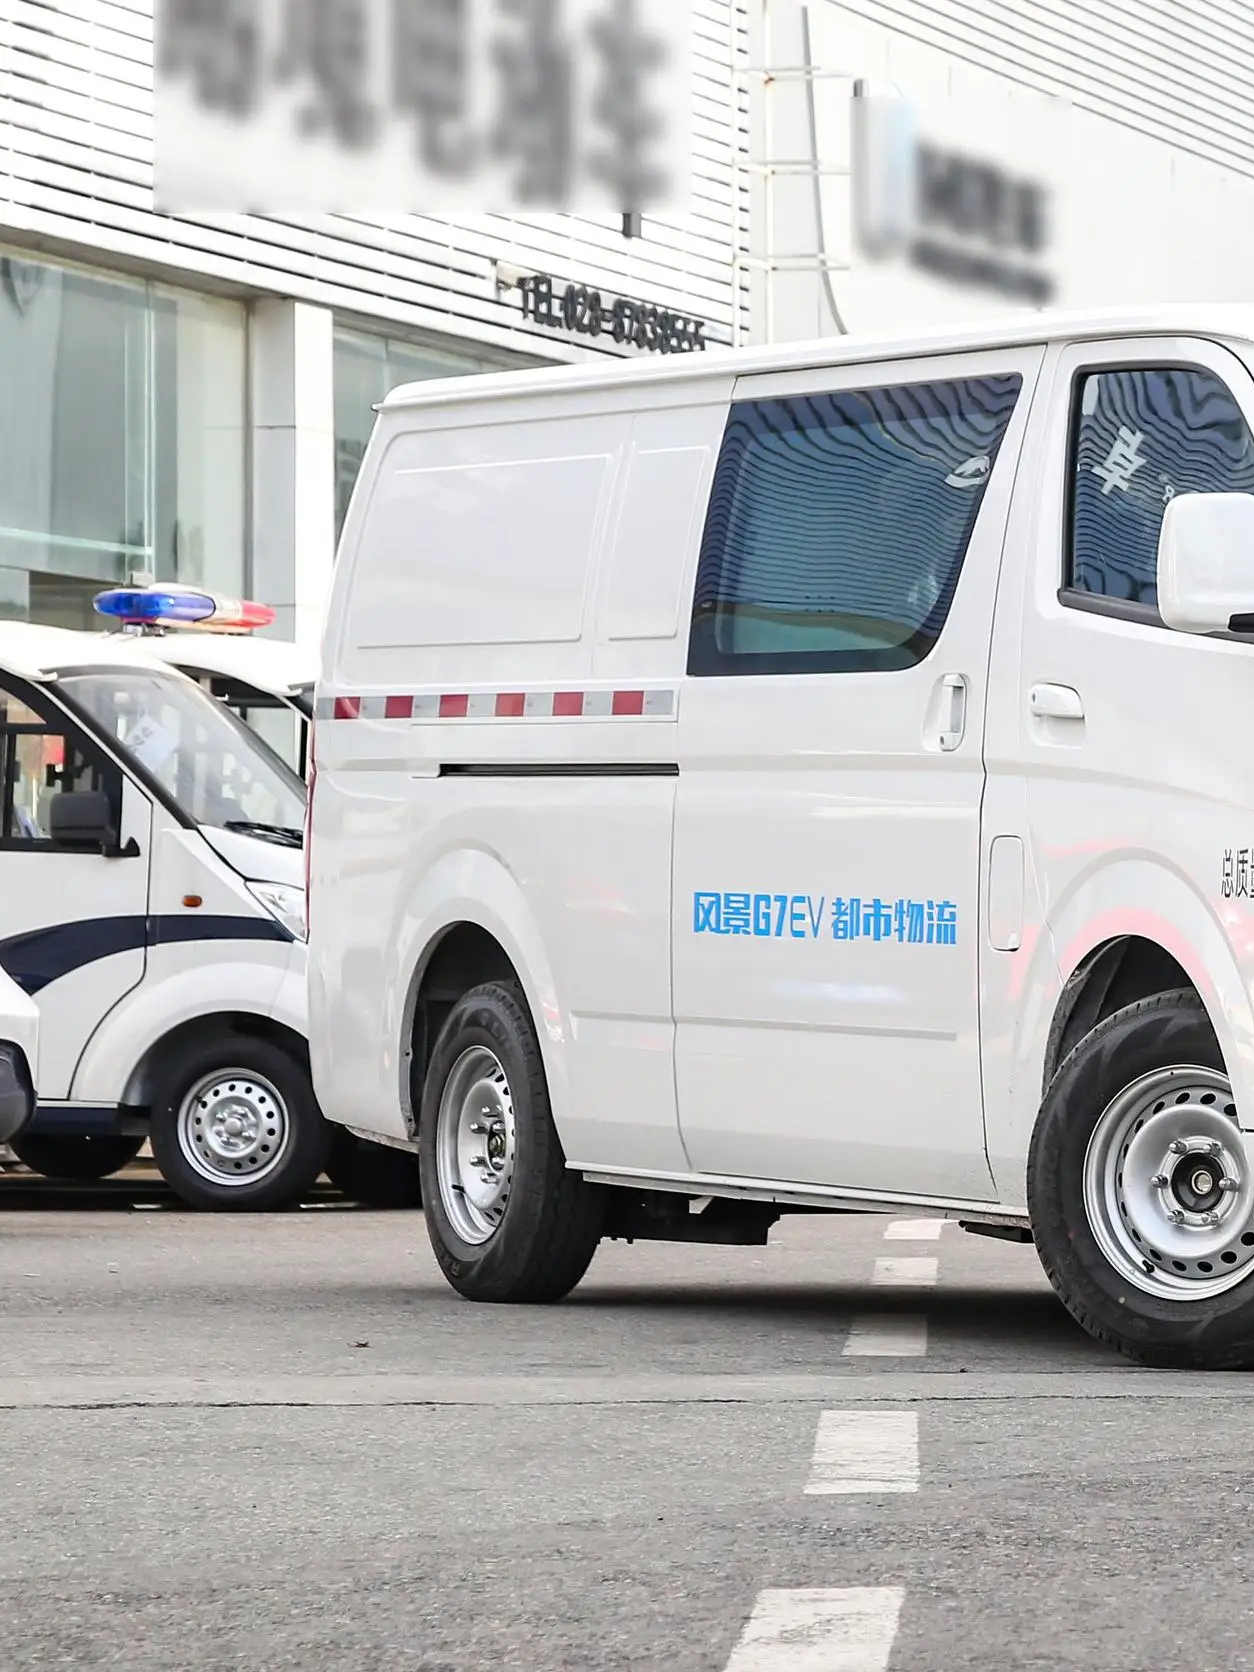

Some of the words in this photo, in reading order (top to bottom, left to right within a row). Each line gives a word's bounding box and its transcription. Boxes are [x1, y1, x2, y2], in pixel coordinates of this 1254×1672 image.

[693, 891, 825, 938] 风景G7EV
[831, 897, 957, 945] 都市物流
